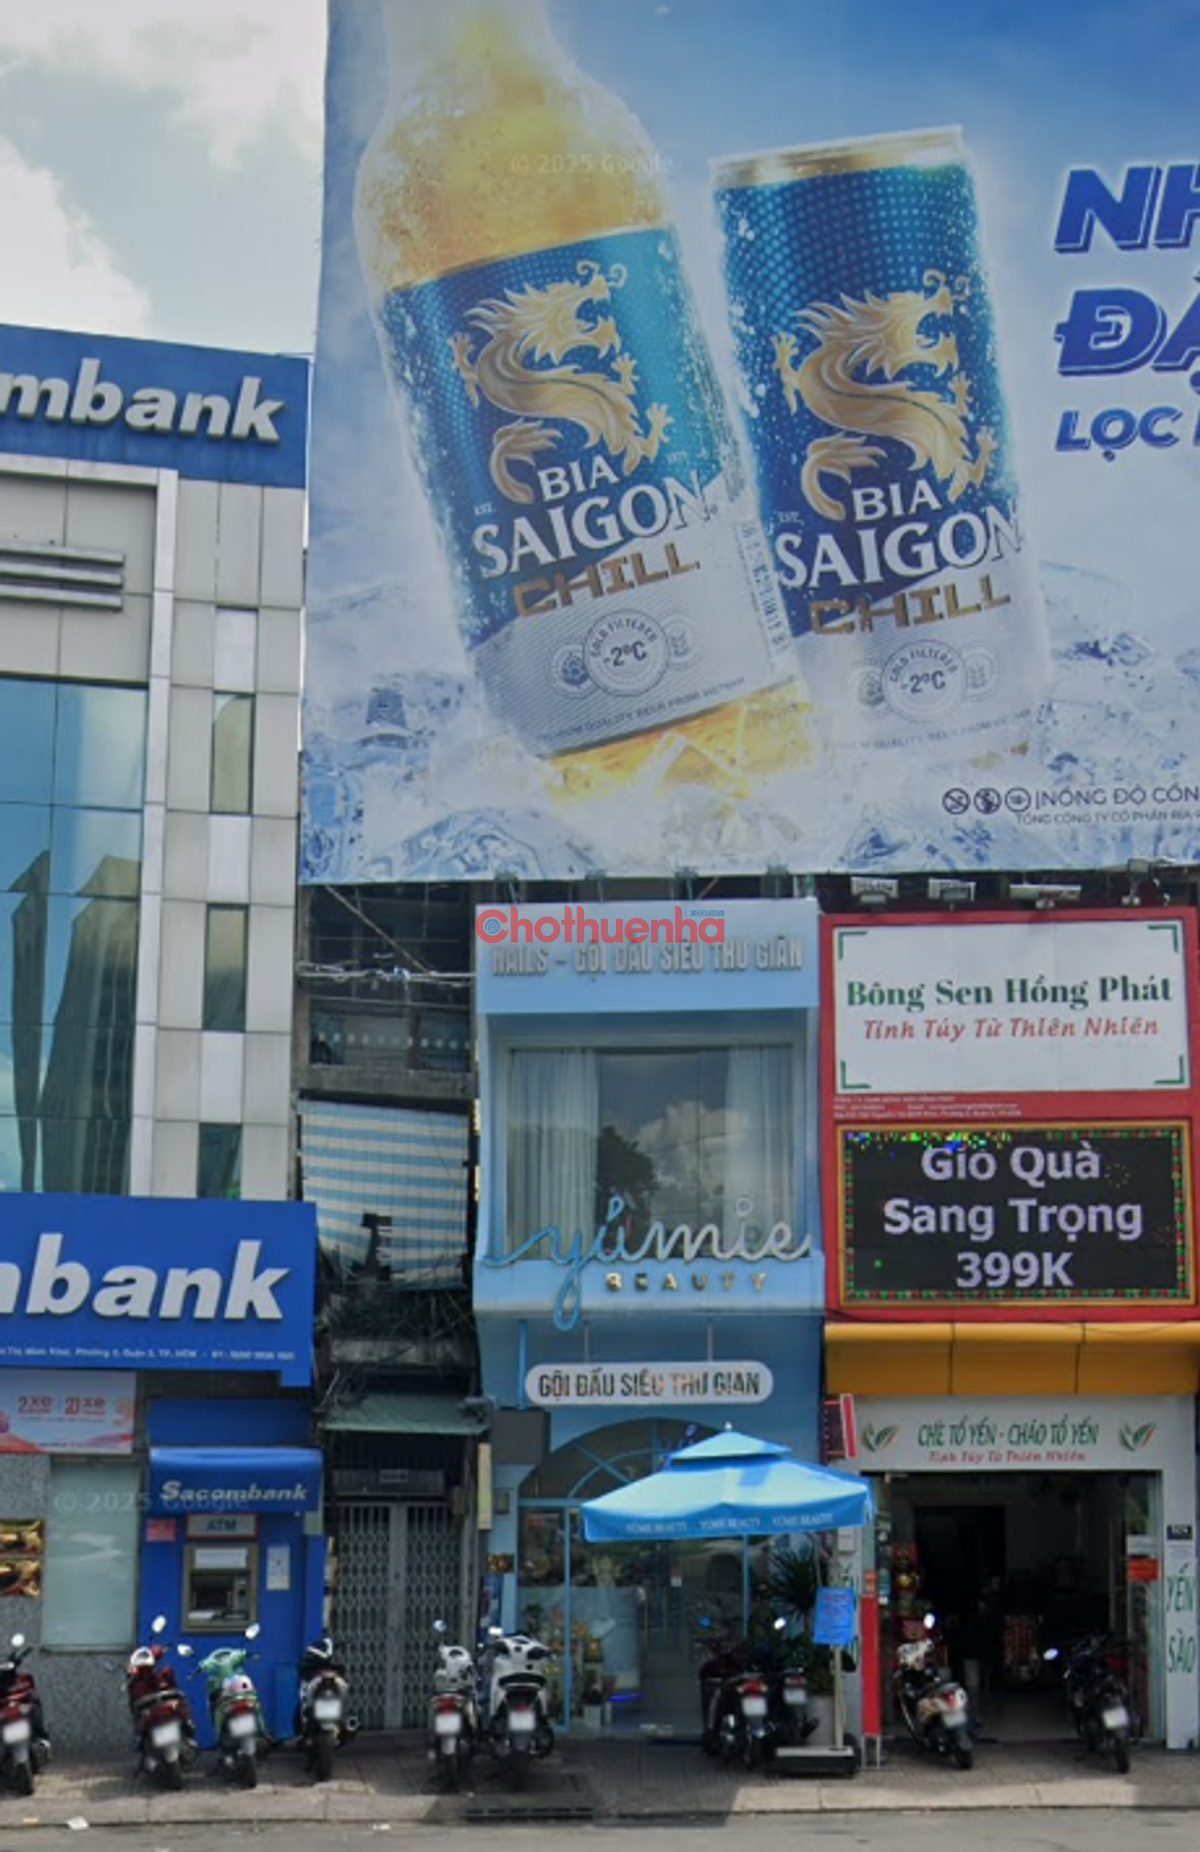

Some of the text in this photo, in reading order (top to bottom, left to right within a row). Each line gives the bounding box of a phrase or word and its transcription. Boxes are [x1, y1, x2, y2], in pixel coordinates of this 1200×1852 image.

[0, 357, 285, 443] mbank
[1055, 407, 1182, 462] LỌC
[537, 454, 620, 501] BIA
[852, 479, 943, 521] BIA
[472, 469, 710, 579] SAIGON
[774, 498, 1022, 589] SAIGON
[514, 542, 700, 617] CHILL
[809, 574, 1011, 635] CHILL
[847, 973, 1174, 1013] Bông Sen Hồng Phát
[1010, 1140, 1100, 1188] Quà
[884, 1198, 1142, 1242] Sang Trọng
[0, 1233, 290, 1319] bank
[606, 1271, 768, 1292] BEAUTY
[956, 1251, 1074, 1287] 399K
[540, 1369, 570, 1402] GỘI
[160, 1480, 308, 1501] Sacombank
